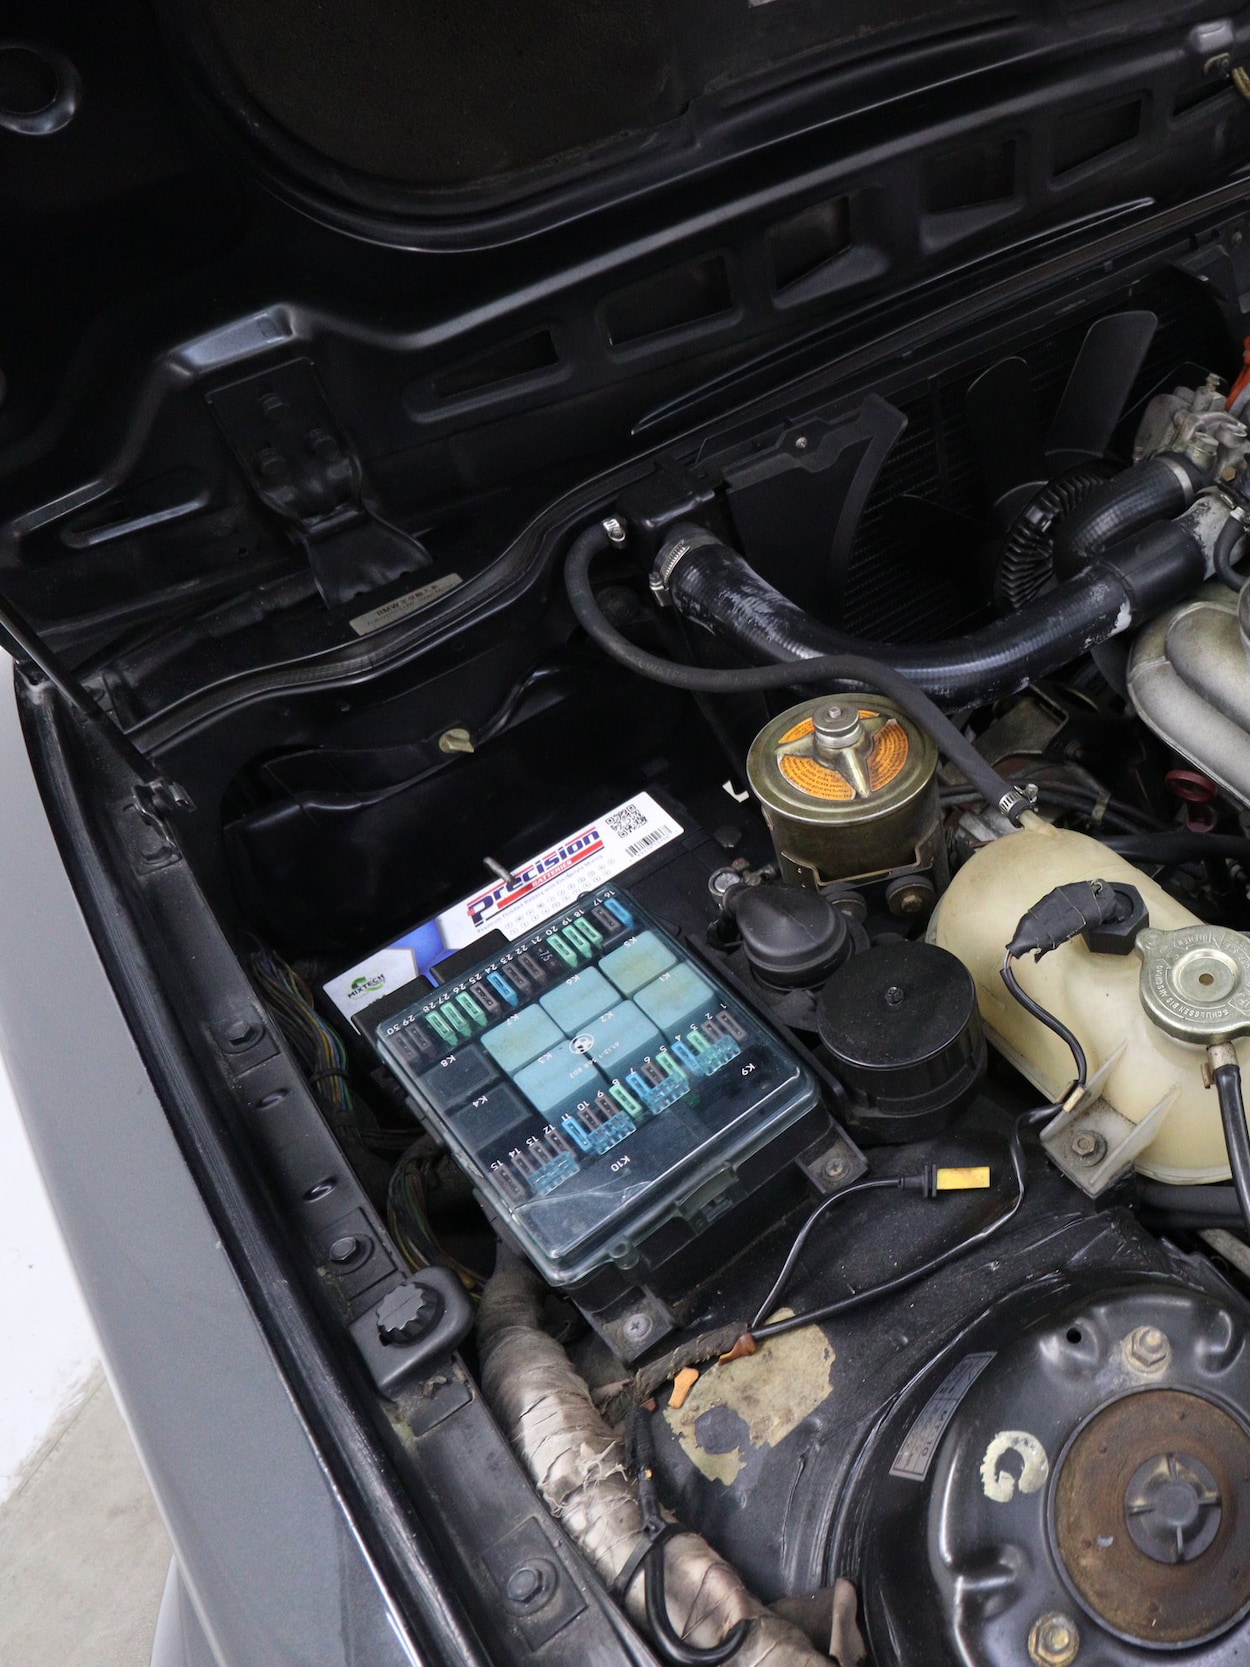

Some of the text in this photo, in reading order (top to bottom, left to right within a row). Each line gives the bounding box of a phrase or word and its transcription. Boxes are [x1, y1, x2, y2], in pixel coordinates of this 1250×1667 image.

[467, 830, 600, 925] Precision
[532, 859, 573, 888] BATTERIES
[623, 936, 638, 948] K5
[386, 890, 616, 1036] 16 17 18 19 20 21 22 23 24 25 26 27 28 29 30
[565, 974, 580, 986] K6
[658, 972, 672, 982] K1
[347, 973, 386, 999] MIXTECH
[506, 1013, 520, 1026] K7
[599, 1010, 615, 1023] K2
[704, 1012, 713, 1020] 2
[689, 1023, 698, 1032] 3
[659, 1045, 668, 1054] 5
[440, 1054, 456, 1068] K8
[537, 1052, 553, 1064] K3
[643, 1056, 651, 1065] 6
[741, 1062, 756, 1076] K9
[611, 1078, 620, 1086] 8
[597, 1090, 605, 1098] 9
[472, 1095, 489, 1108] K4
[576, 1100, 590, 1111] 10
[561, 1113, 573, 1121] 11
[542, 1124, 557, 1135] 12
[525, 1136, 539, 1147] 13
[508, 1147, 522, 1159] 14
[490, 1160, 504, 1171] 15
[610, 1155, 631, 1172] K10
